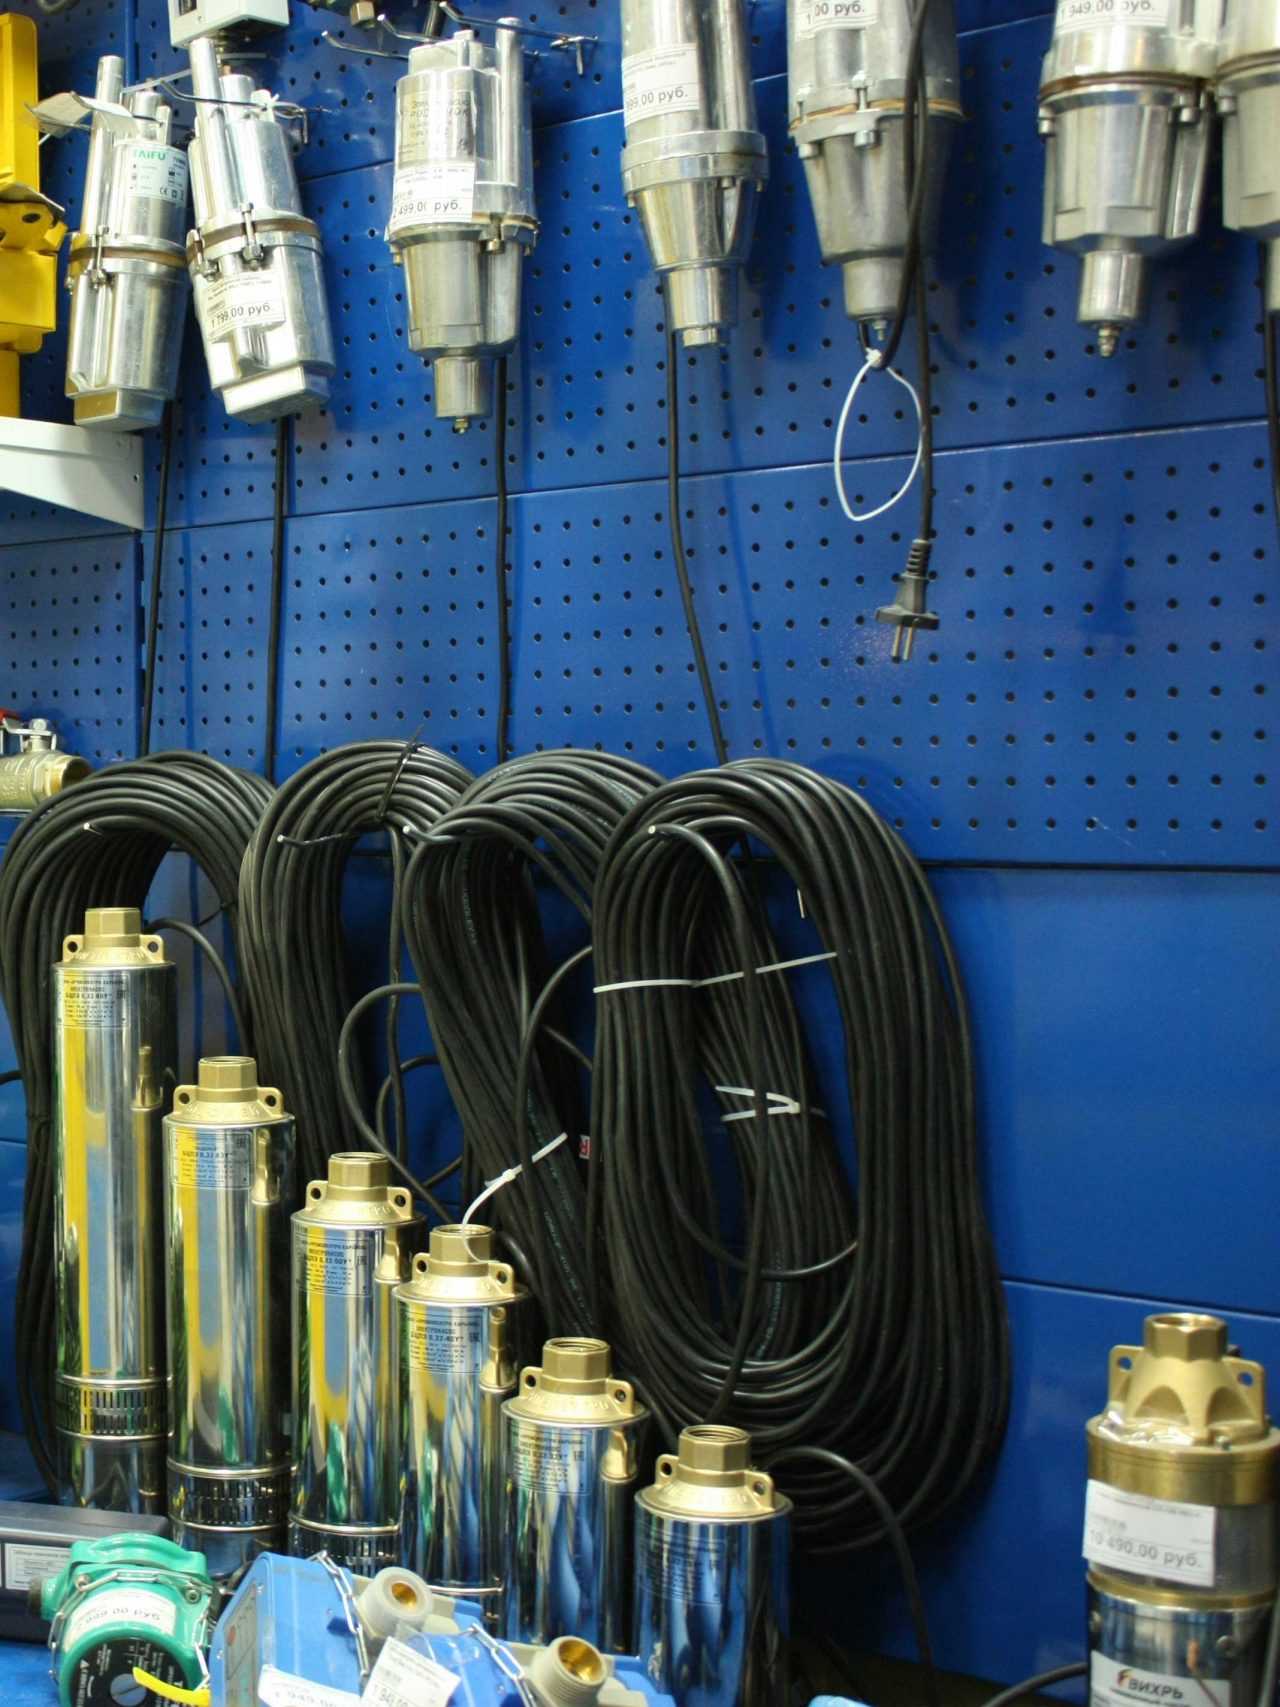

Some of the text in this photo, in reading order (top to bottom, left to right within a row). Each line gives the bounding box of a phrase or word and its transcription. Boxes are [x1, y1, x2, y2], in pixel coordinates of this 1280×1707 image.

[834, 0, 865, 17] руб.
[658, 86, 688, 104] руб.
[434, 200, 462, 213] руб.
[248, 302, 274, 316] руб.
[1090, 1529, 1202, 1568] 10 490,00 руб.
[1128, 1678, 1184, 1699] ВИХРЬ
